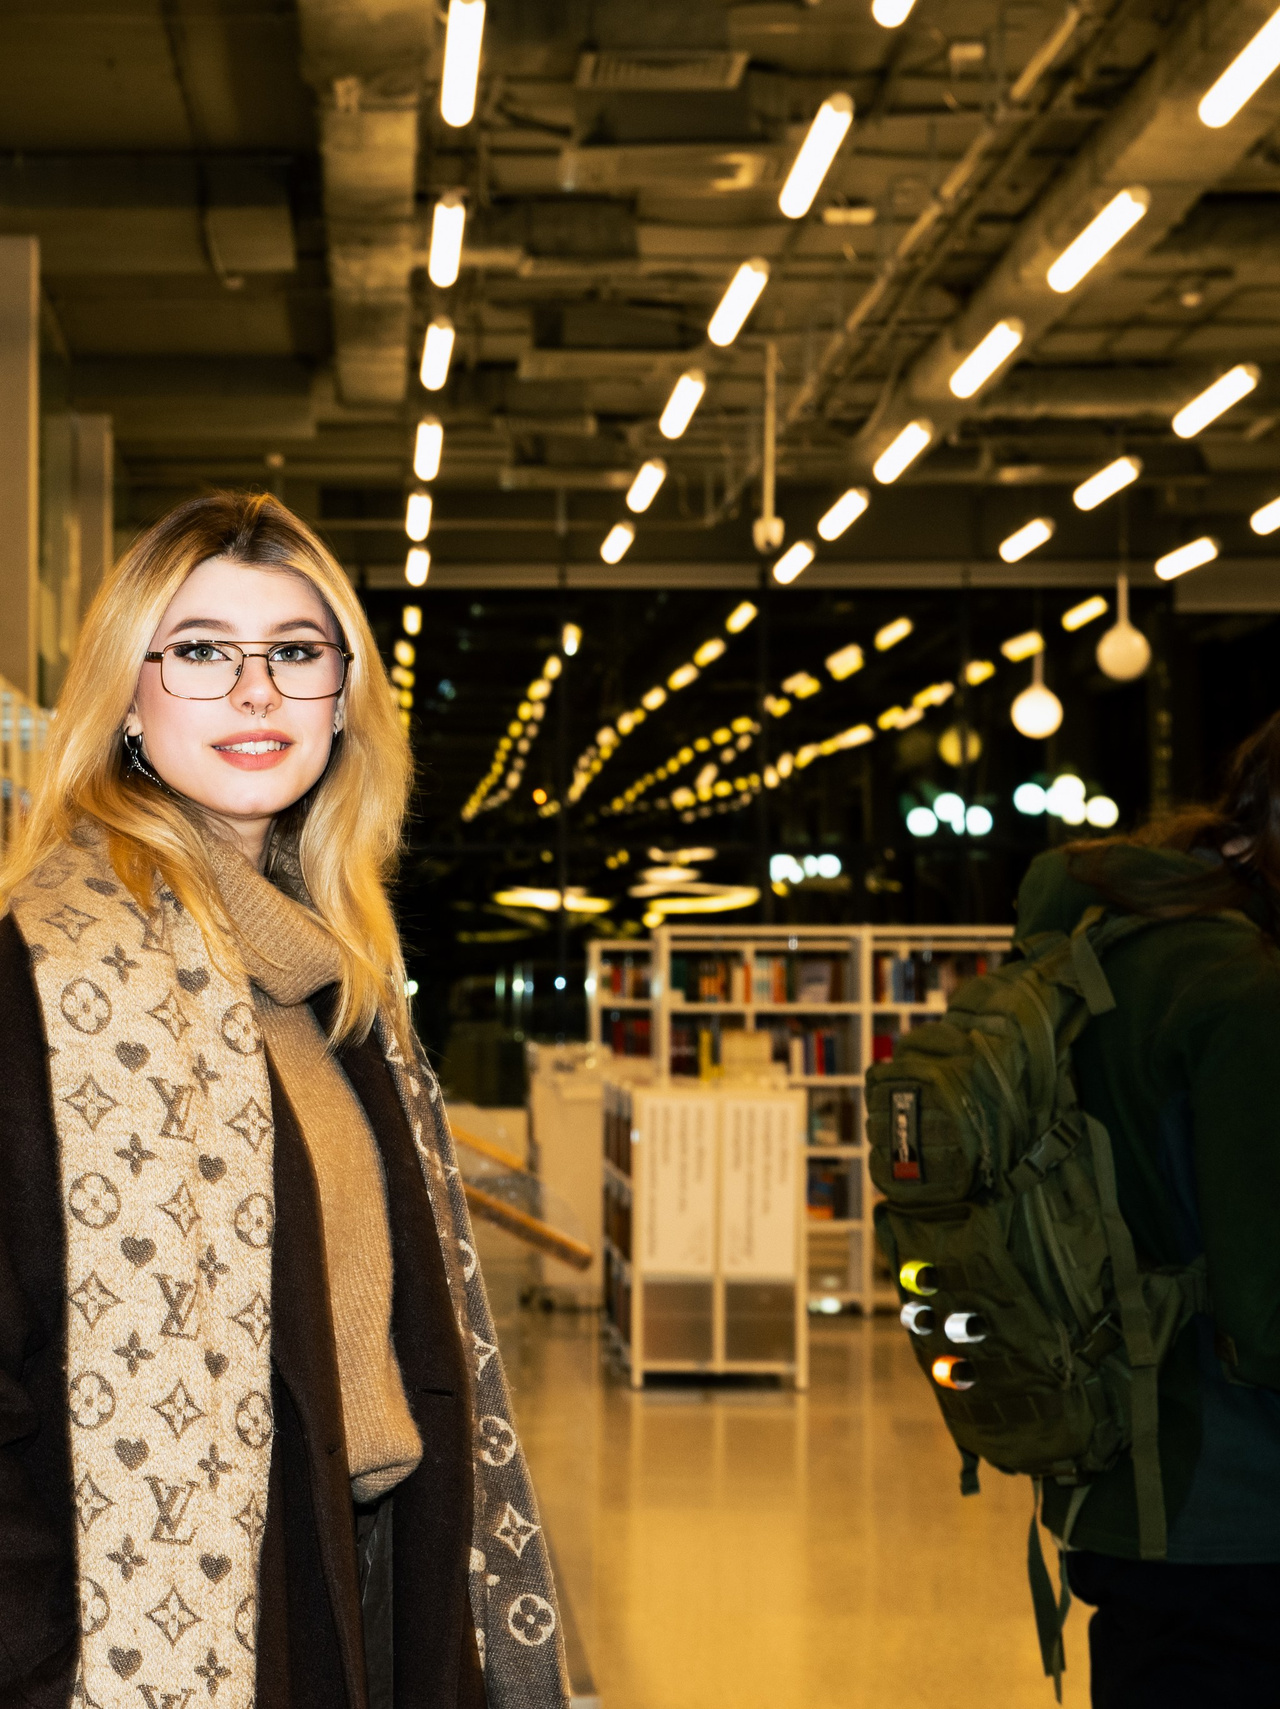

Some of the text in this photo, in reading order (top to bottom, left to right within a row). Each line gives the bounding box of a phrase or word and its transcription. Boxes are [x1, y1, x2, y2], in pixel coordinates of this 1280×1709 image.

[146, 1075, 198, 1144] LV
[150, 1272, 201, 1341] LV
[142, 1475, 200, 1546] LV
